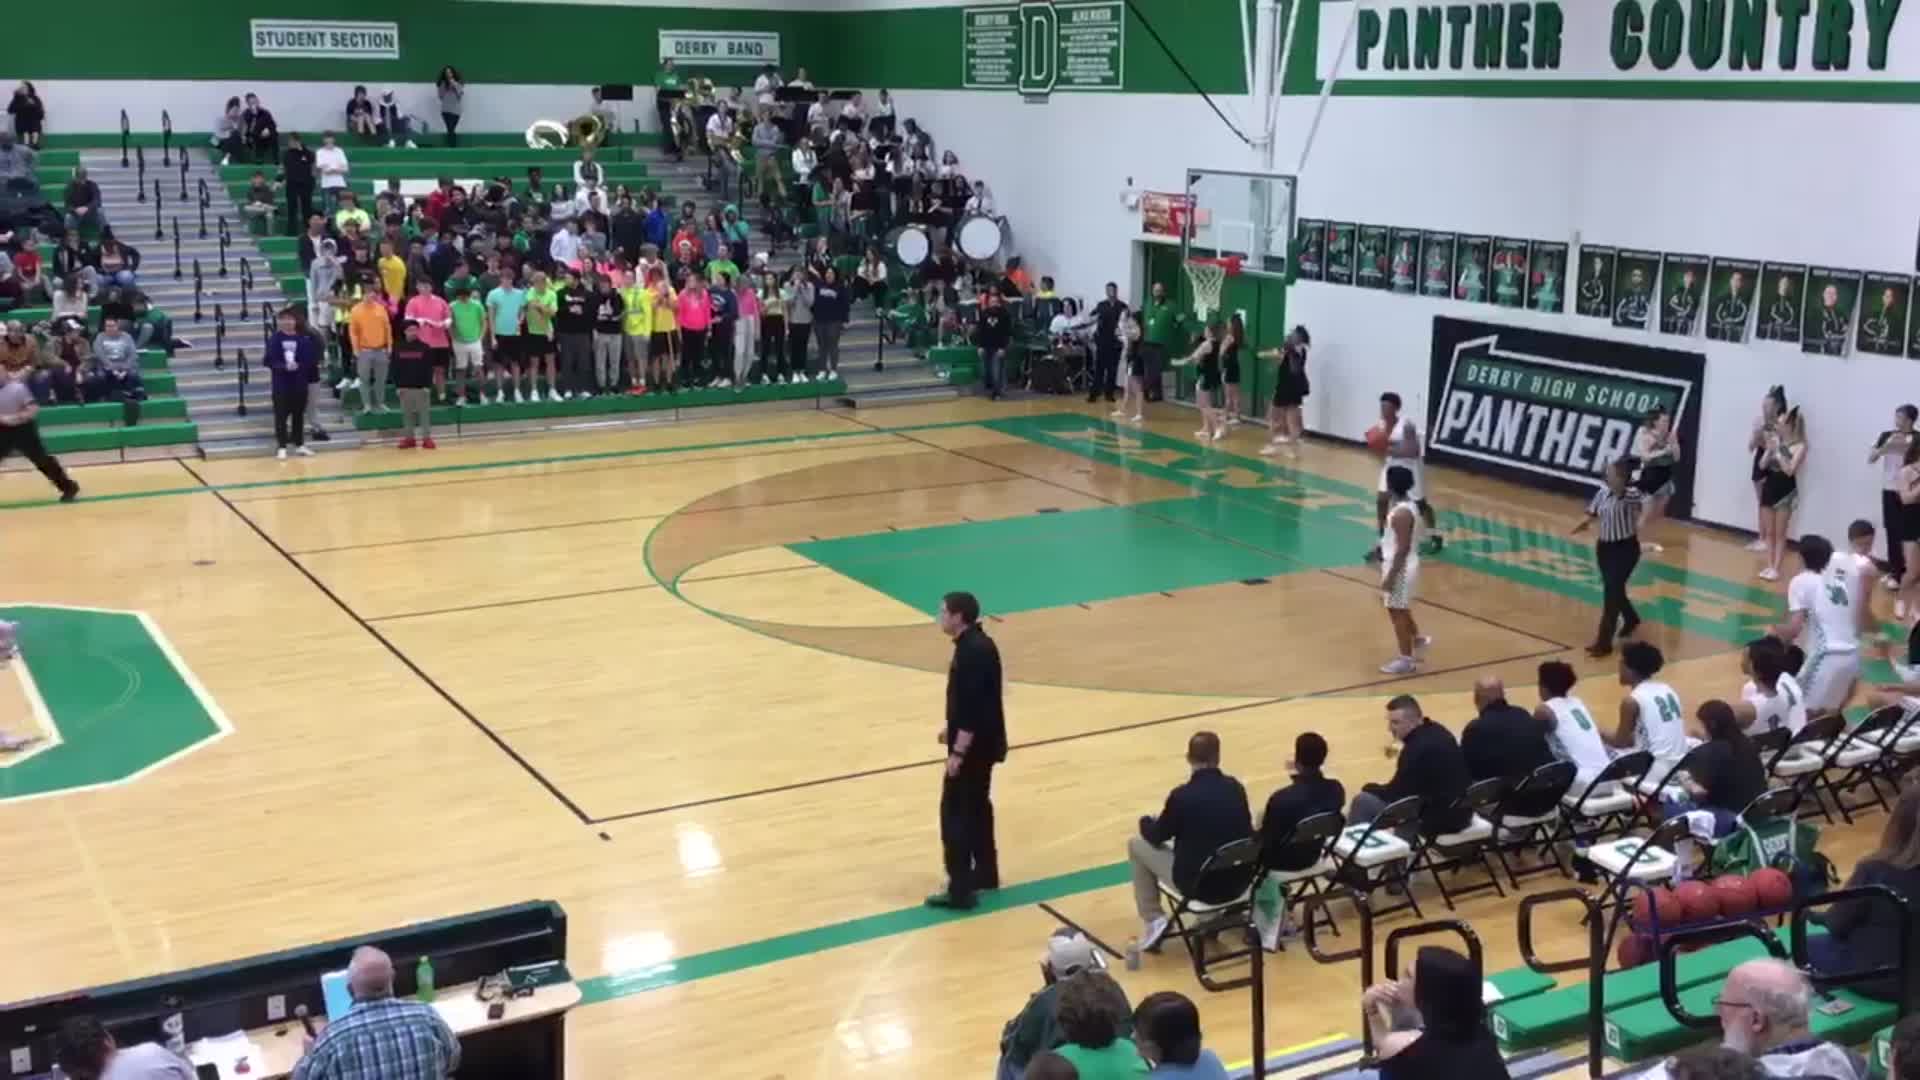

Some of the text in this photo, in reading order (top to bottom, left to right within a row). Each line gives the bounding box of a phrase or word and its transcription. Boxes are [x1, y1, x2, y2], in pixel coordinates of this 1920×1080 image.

[255, 31, 395, 49] STUDENT SECTION
[674, 40, 764, 56] DERBY BAND
[1355, 0, 1901, 71] PANTHER COUNTRY
[1466, 363, 1524, 391] DERBY
[1530, 375, 1577, 401] HIGH
[1440, 389, 1648, 474] PANTHER
